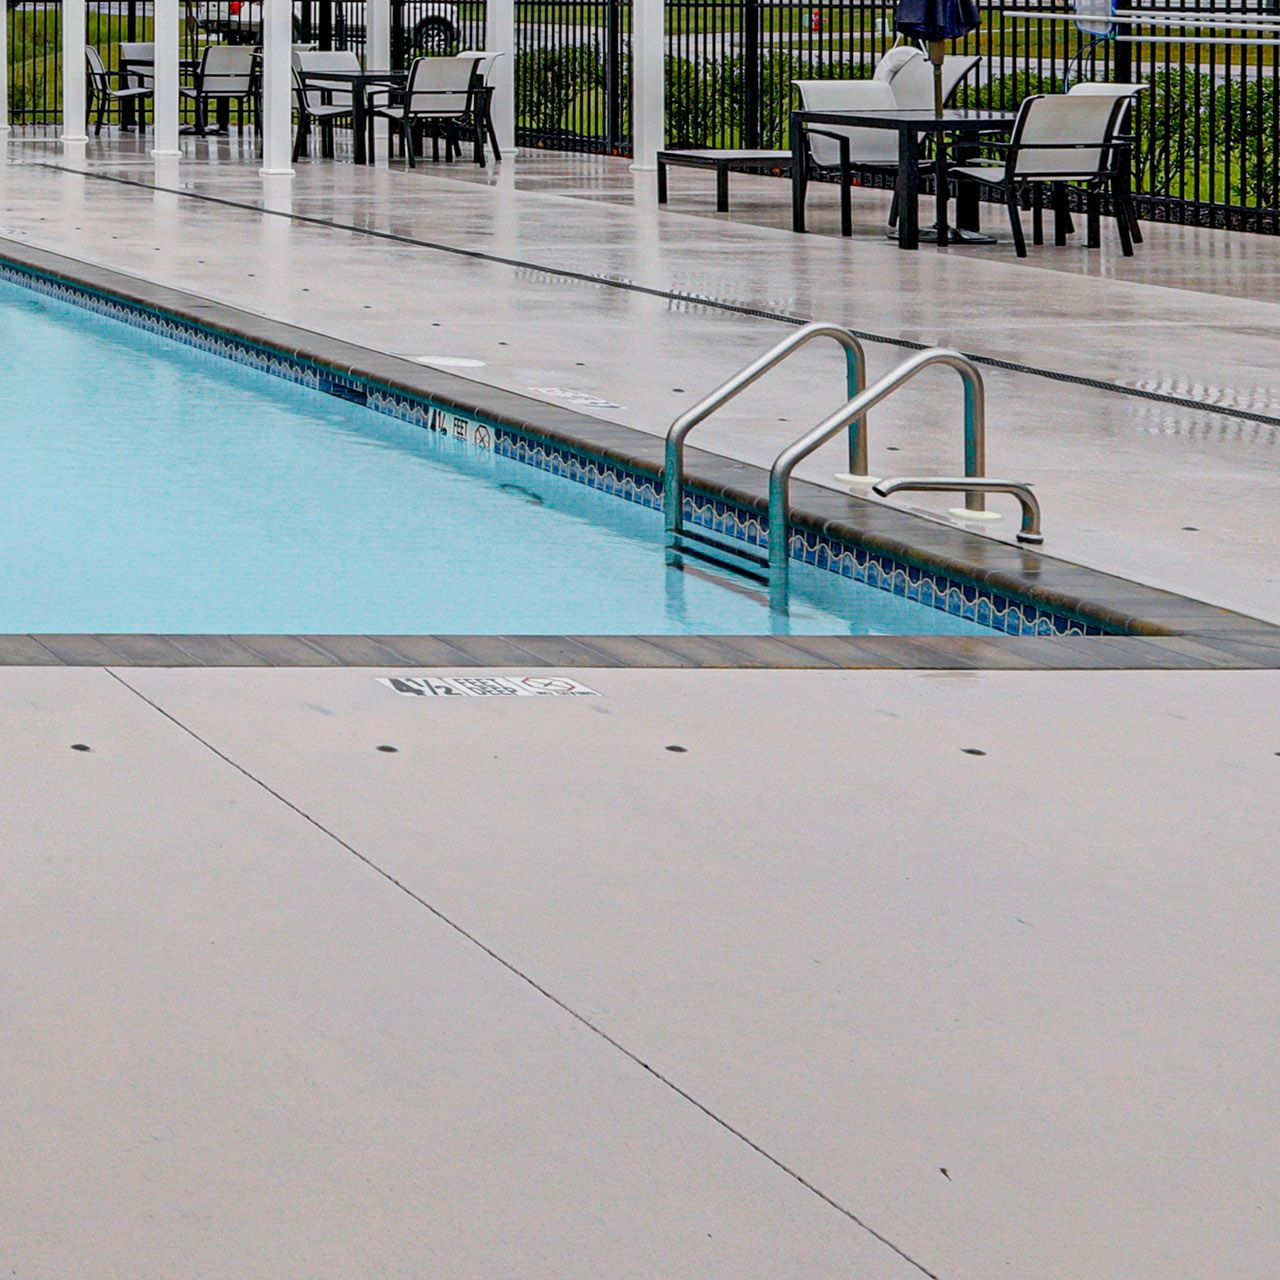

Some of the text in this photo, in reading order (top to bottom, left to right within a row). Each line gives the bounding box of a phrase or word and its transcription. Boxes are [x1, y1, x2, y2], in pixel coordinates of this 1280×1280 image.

[453, 416, 468, 438] FEET
[452, 678, 504, 688] FEET
[466, 686, 518, 696] DEEP
